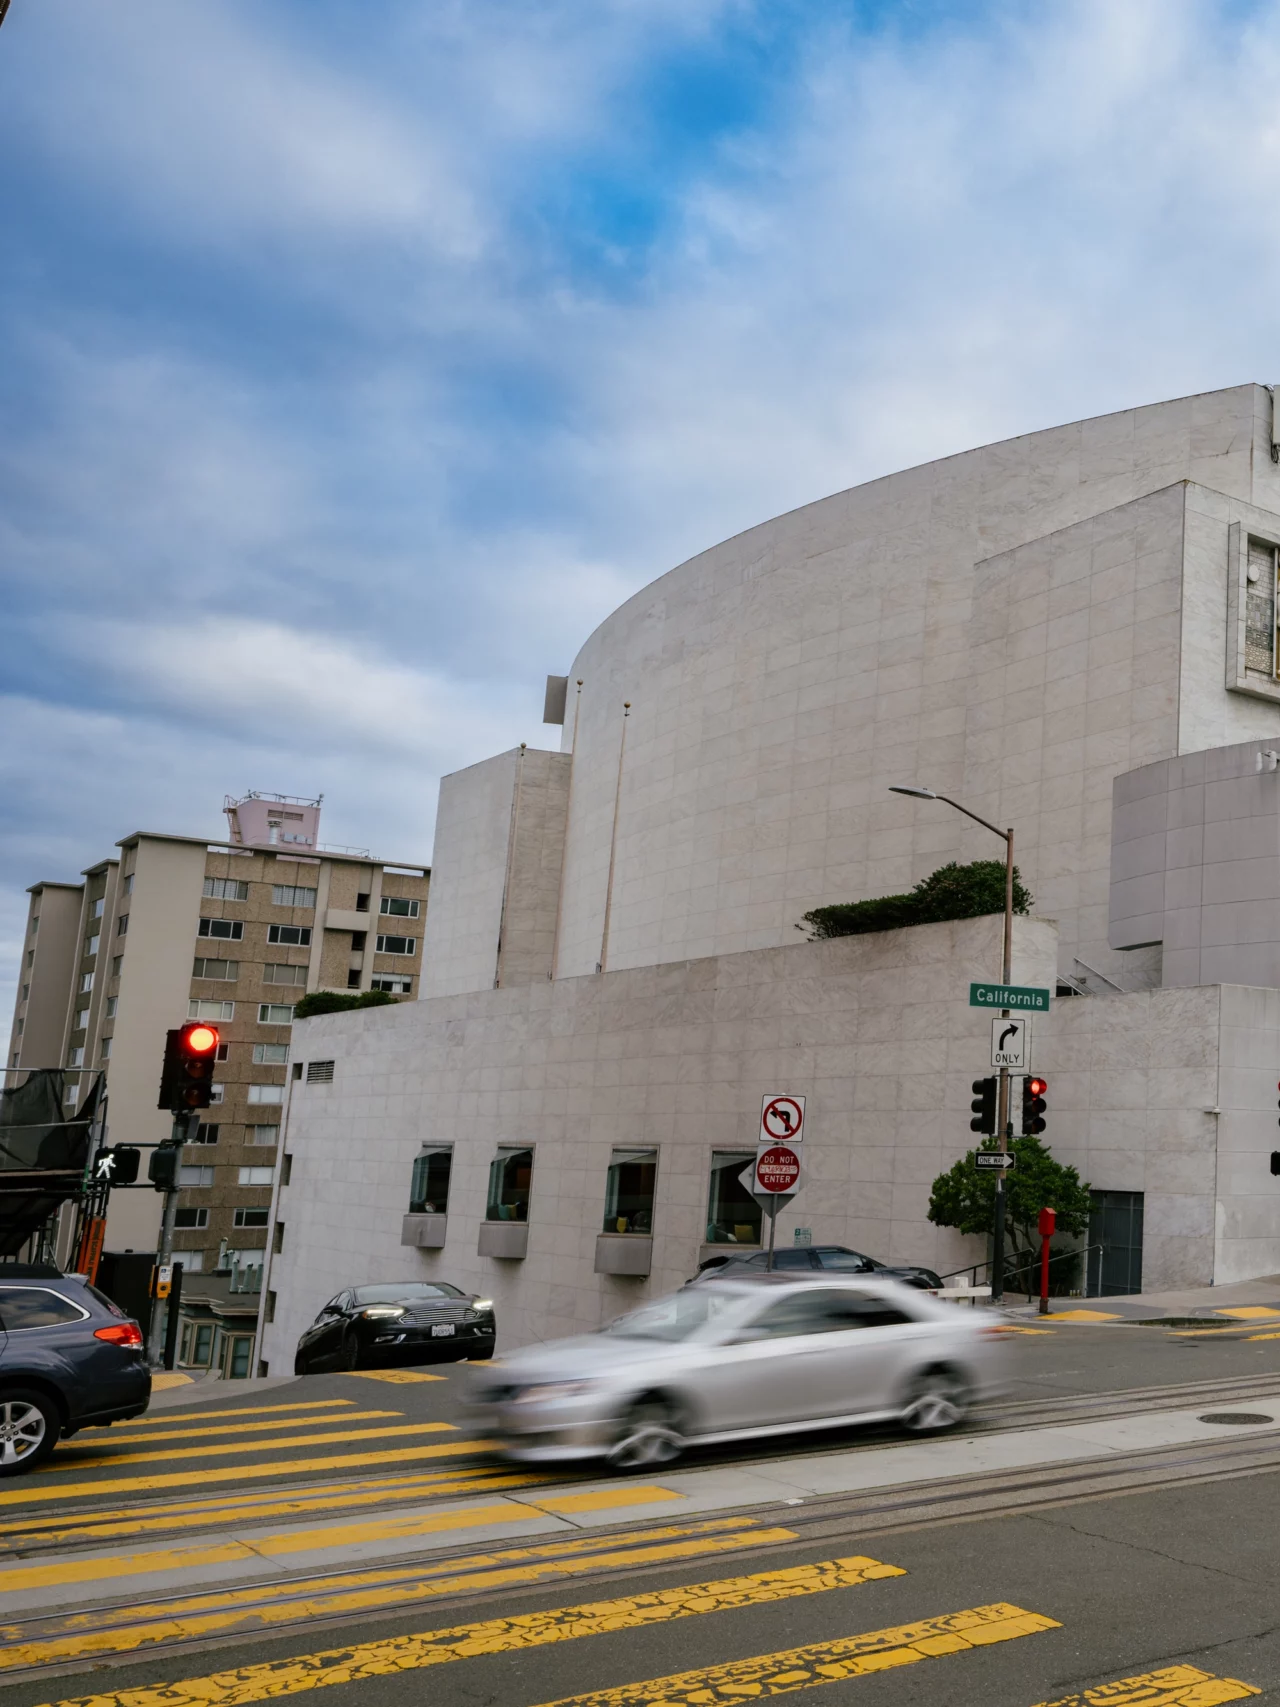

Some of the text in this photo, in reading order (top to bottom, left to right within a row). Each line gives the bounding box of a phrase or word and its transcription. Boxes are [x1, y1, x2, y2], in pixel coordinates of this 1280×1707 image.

[977, 988, 1043, 1006] California
[995, 1053, 1020, 1064] ONLY
[764, 1155, 794, 1164] DO NOT
[764, 1175, 791, 1183] ENTER
